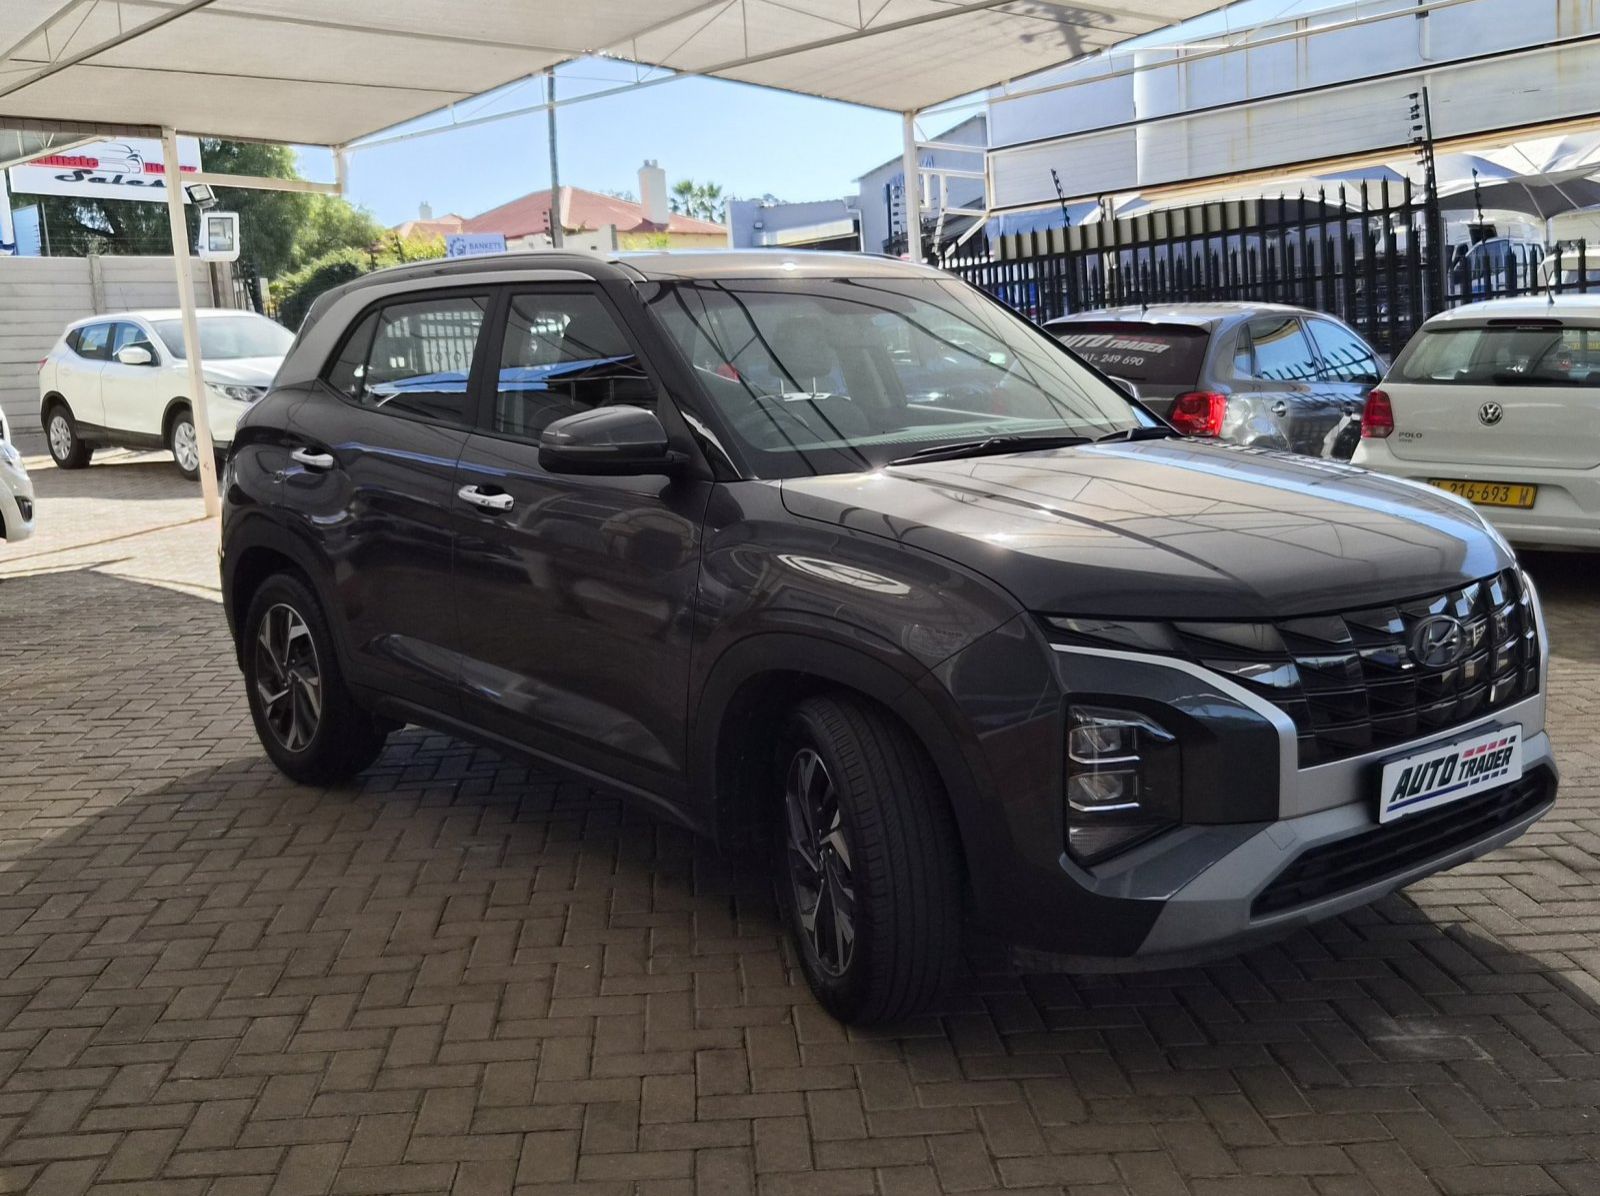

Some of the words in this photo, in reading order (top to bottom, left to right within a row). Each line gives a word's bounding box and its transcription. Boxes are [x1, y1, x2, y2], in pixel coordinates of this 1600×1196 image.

[55, 169, 166, 188] Sales
[1105, 340, 1170, 353] TRADER
[1101, 353, 1121, 363] 249
[1122, 356, 1144, 366] 690
[1390, 753, 1459, 803] AUTO
[1458, 746, 1513, 781] TRADER
